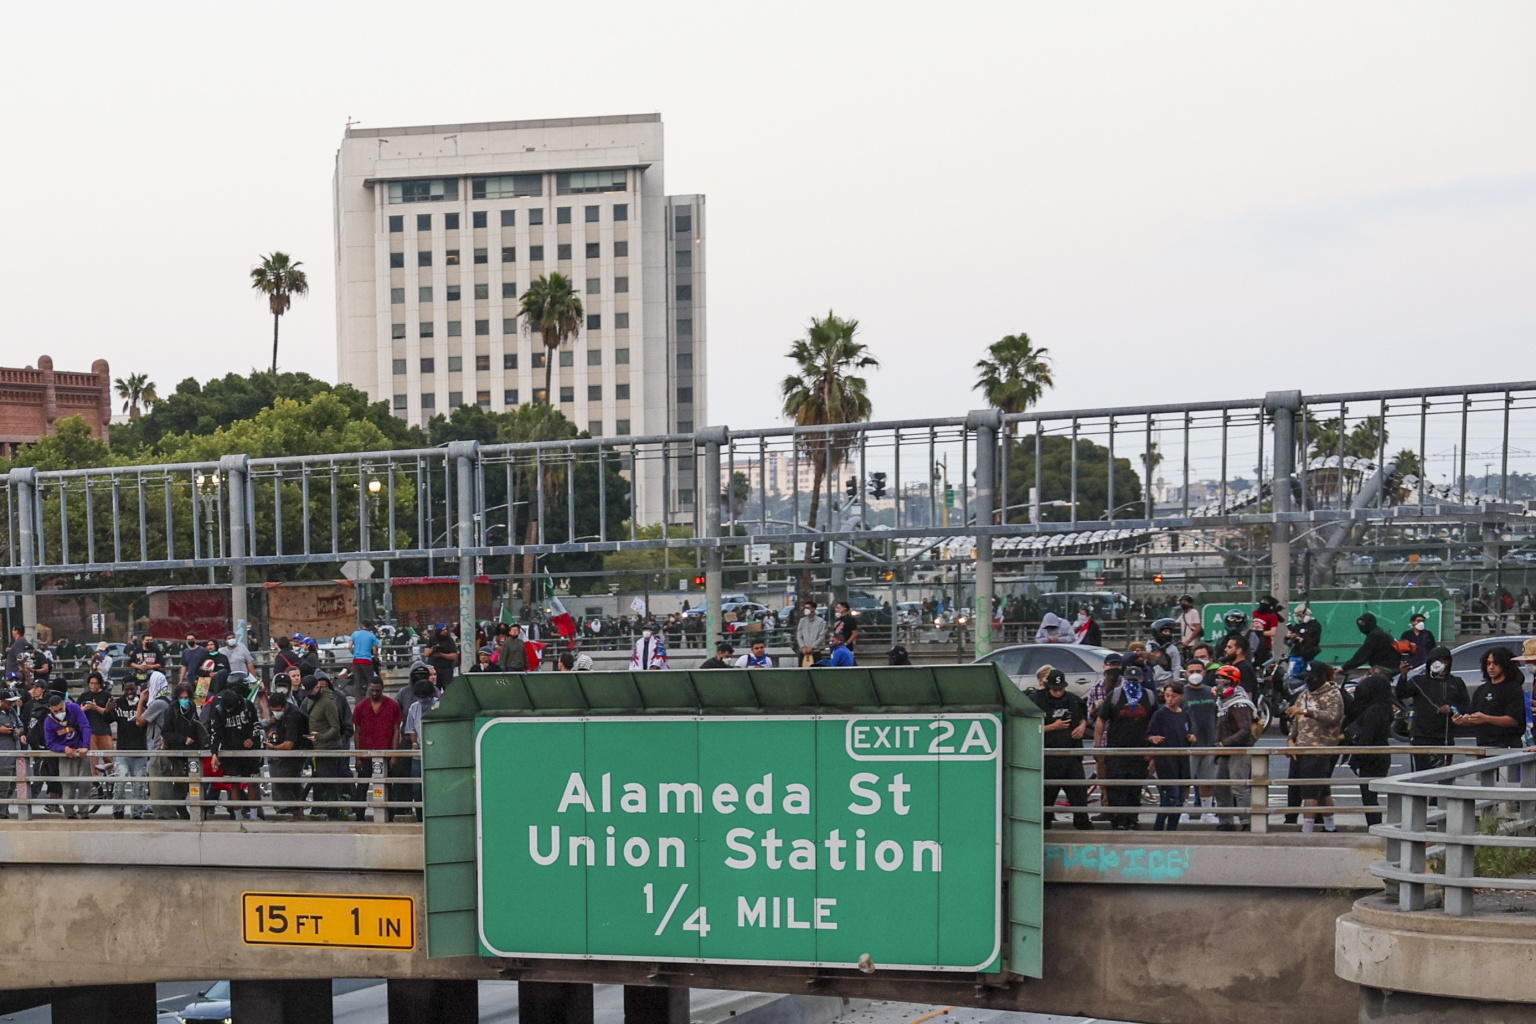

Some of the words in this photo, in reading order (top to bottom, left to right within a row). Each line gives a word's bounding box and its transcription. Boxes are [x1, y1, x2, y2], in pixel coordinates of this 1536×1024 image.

[854, 726, 920, 748] EXIT
[928, 720, 993, 753] 2A
[558, 773, 810, 814] Alameda
[848, 773, 911, 815] St
[529, 826, 685, 868] Union
[725, 828, 941, 871] Station
[256, 905, 288, 933] 15
[296, 915, 323, 934] FT
[351, 907, 359, 935] 1
[379, 918, 401, 937] IN
[644, 884, 711, 936] 1/4
[738, 896, 837, 930] MILE
